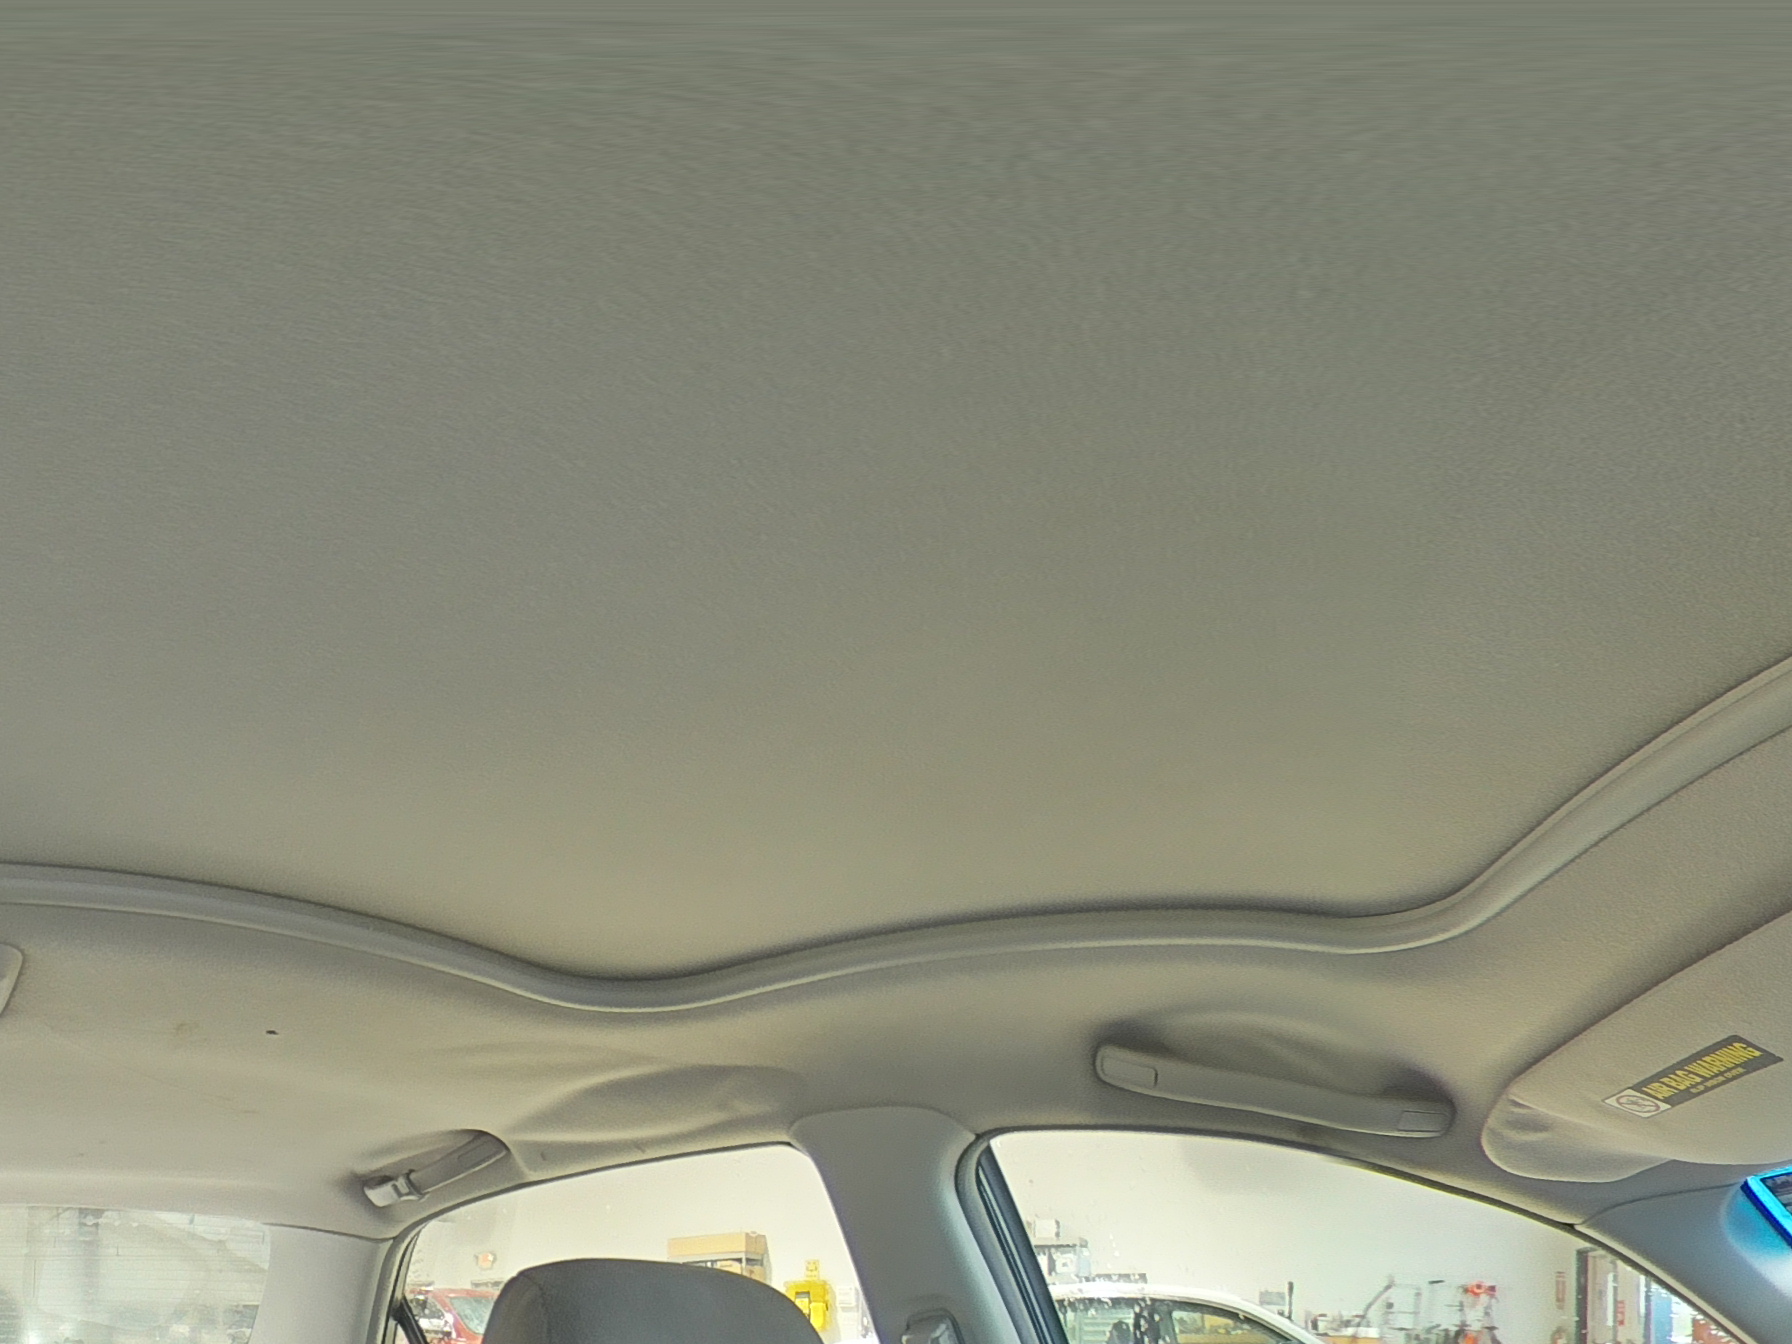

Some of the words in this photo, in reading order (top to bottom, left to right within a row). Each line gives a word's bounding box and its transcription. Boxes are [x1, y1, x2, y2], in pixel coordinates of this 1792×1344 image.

[1642, 1083, 1678, 1099] AIR
[1660, 1071, 1703, 1089] BAG
[1684, 1043, 1762, 1079] WARNING
